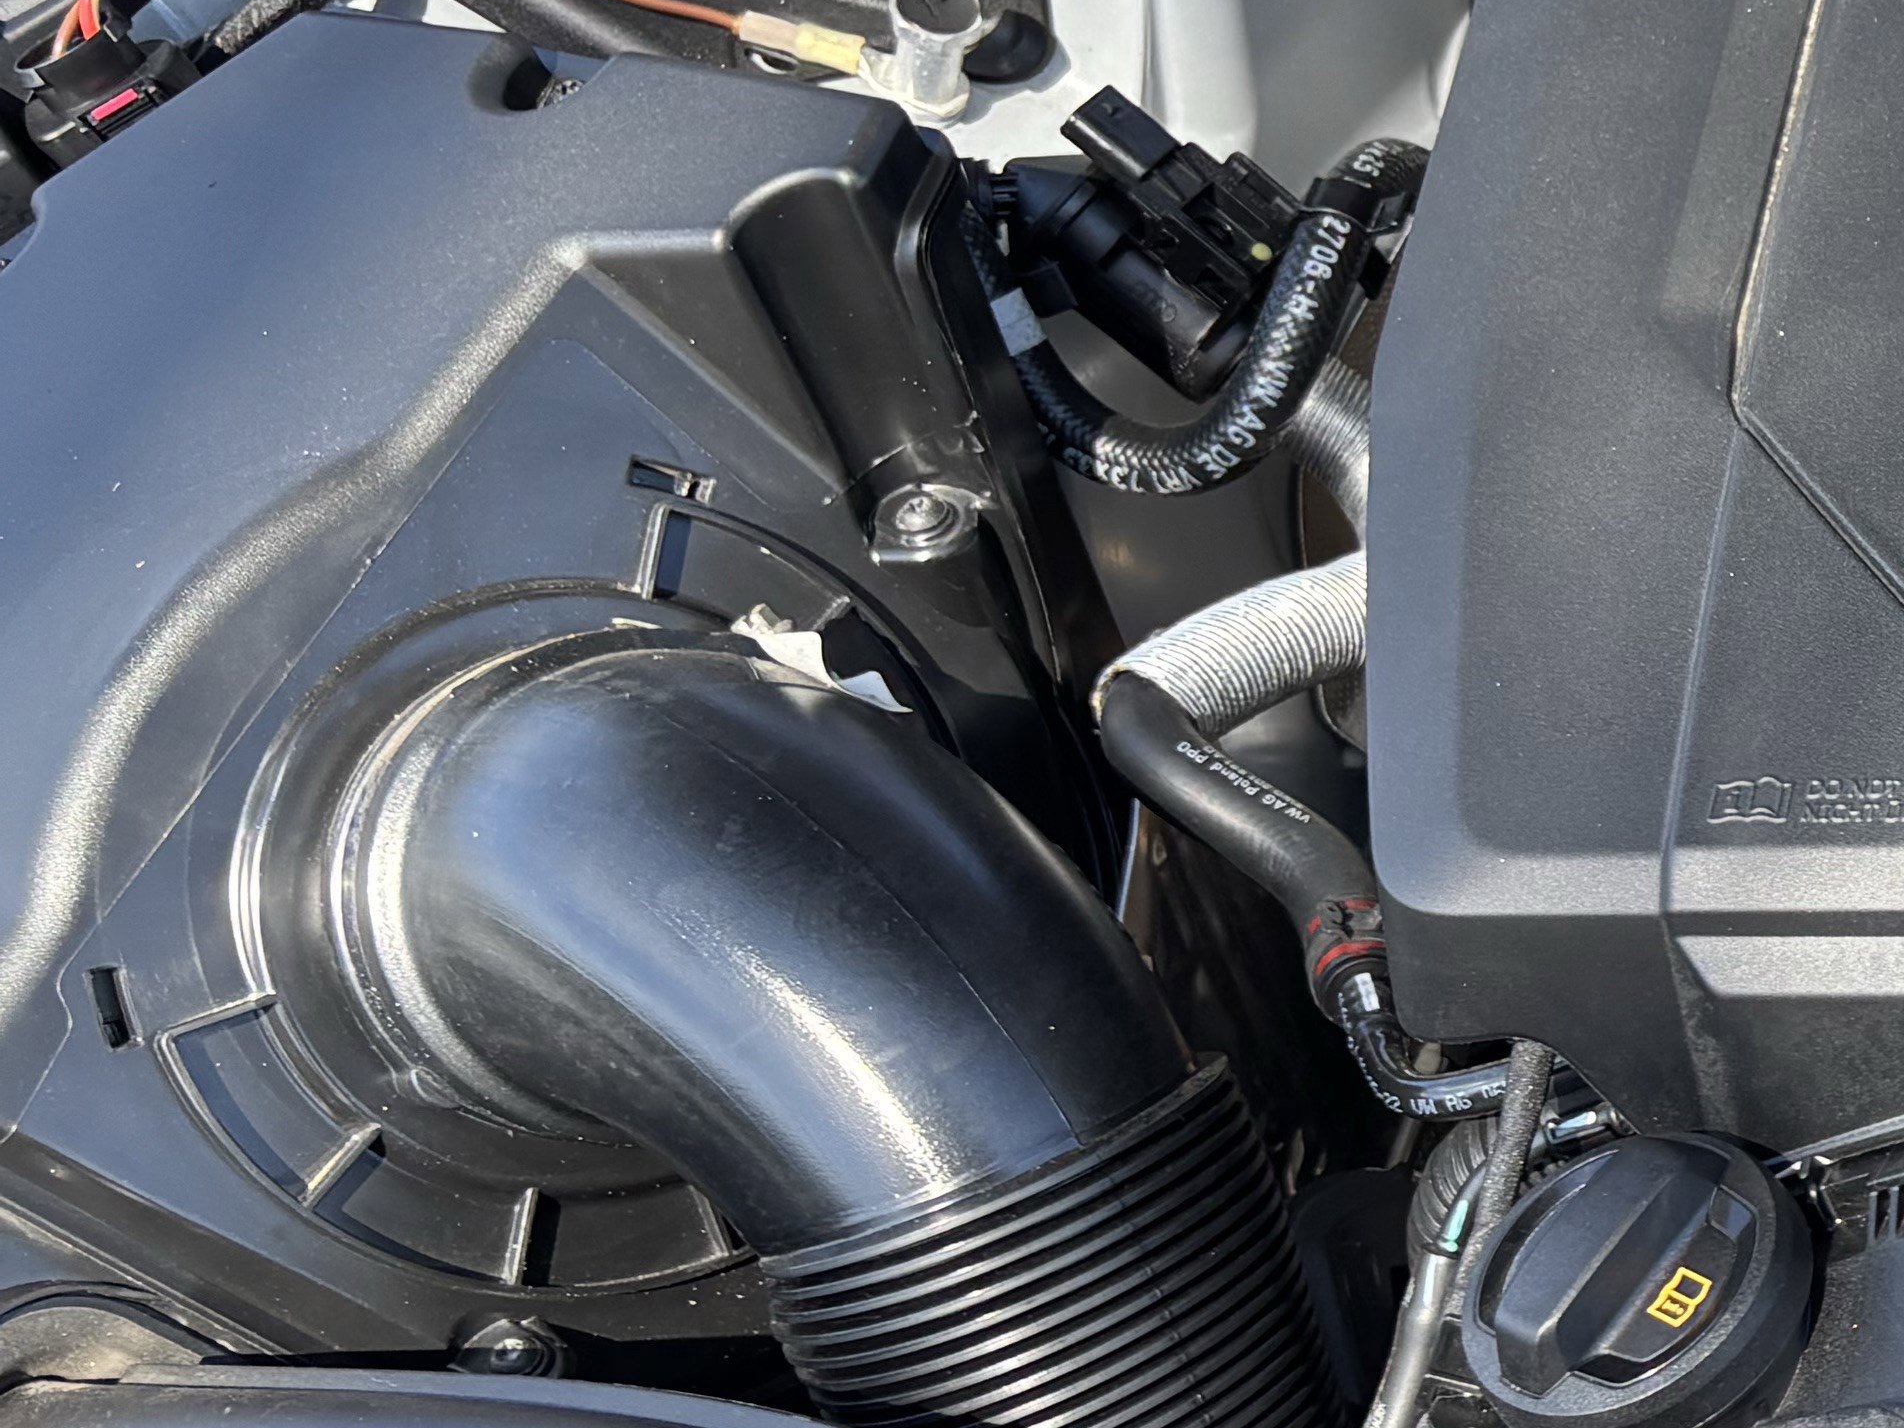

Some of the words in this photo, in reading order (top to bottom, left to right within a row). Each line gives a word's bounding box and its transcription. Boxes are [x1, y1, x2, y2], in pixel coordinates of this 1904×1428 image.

[1209, 761, 1261, 796] Poland
[1261, 793, 1287, 811] AG
[1284, 807, 1311, 824] VW
